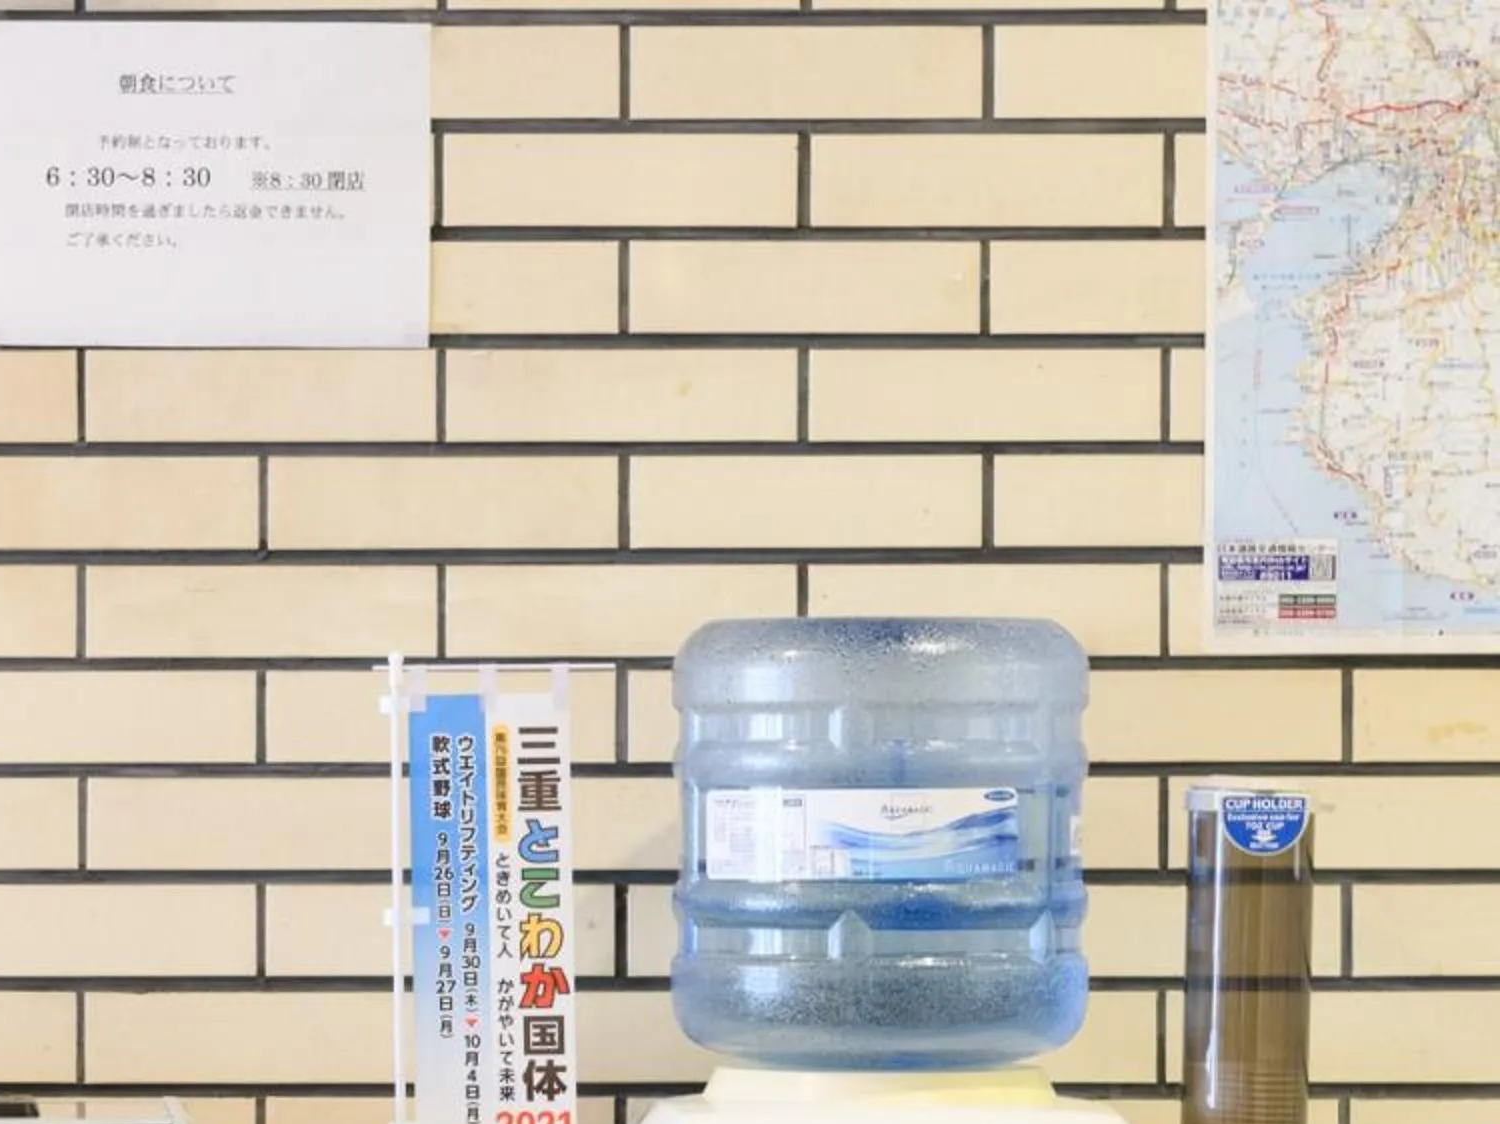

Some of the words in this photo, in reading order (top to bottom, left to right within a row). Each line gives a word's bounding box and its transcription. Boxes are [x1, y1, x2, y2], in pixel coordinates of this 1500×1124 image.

[118, 73, 237, 94] 朝食について
[64, 203, 347, 220] 閉店時間を過ぎましたら返金できません。
[65, 231, 179, 249] ご了承ください。
[431, 734, 453, 820] 軟式野球
[1253, 799, 1303, 809] HOLDER
[494, 852, 514, 959] ときめいて人
[516, 726, 571, 1102] 三重とこわか国体
[496, 977, 516, 1102] かがやいて未来
